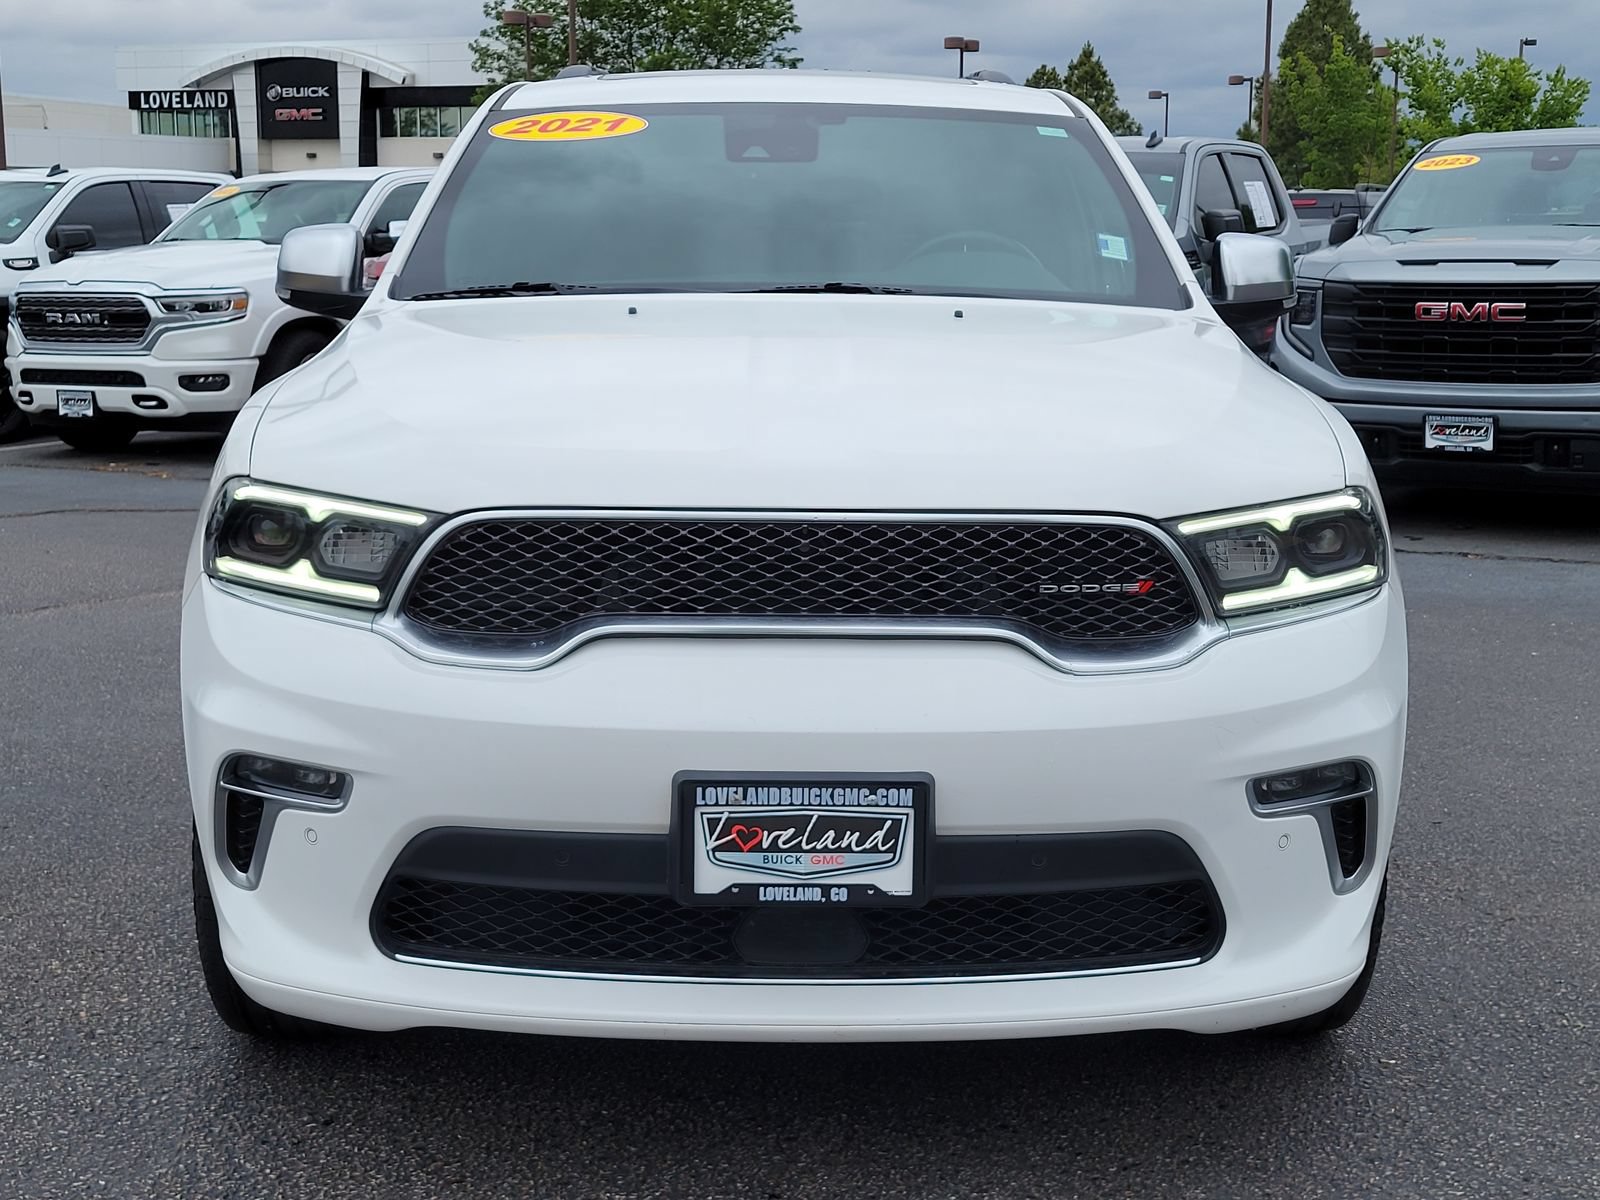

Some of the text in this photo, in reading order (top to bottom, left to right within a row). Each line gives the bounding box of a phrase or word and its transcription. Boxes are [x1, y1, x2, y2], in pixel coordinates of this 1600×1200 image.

[282, 86, 330, 98] BUICK
[140, 91, 229, 109] LOVELAND
[274, 108, 323, 121] GMC
[503, 117, 629, 135] 2021
[1419, 157, 1476, 169] 2023
[45, 312, 100, 325] RAM
[1415, 302, 1526, 322] GMC
[1039, 583, 1140, 593] DODGE
[696, 786, 914, 807] LOVELANDBUICKGMCCOM
[762, 854, 845, 865] BUICK GMC
[758, 886, 848, 903] LOVELAND, CO
